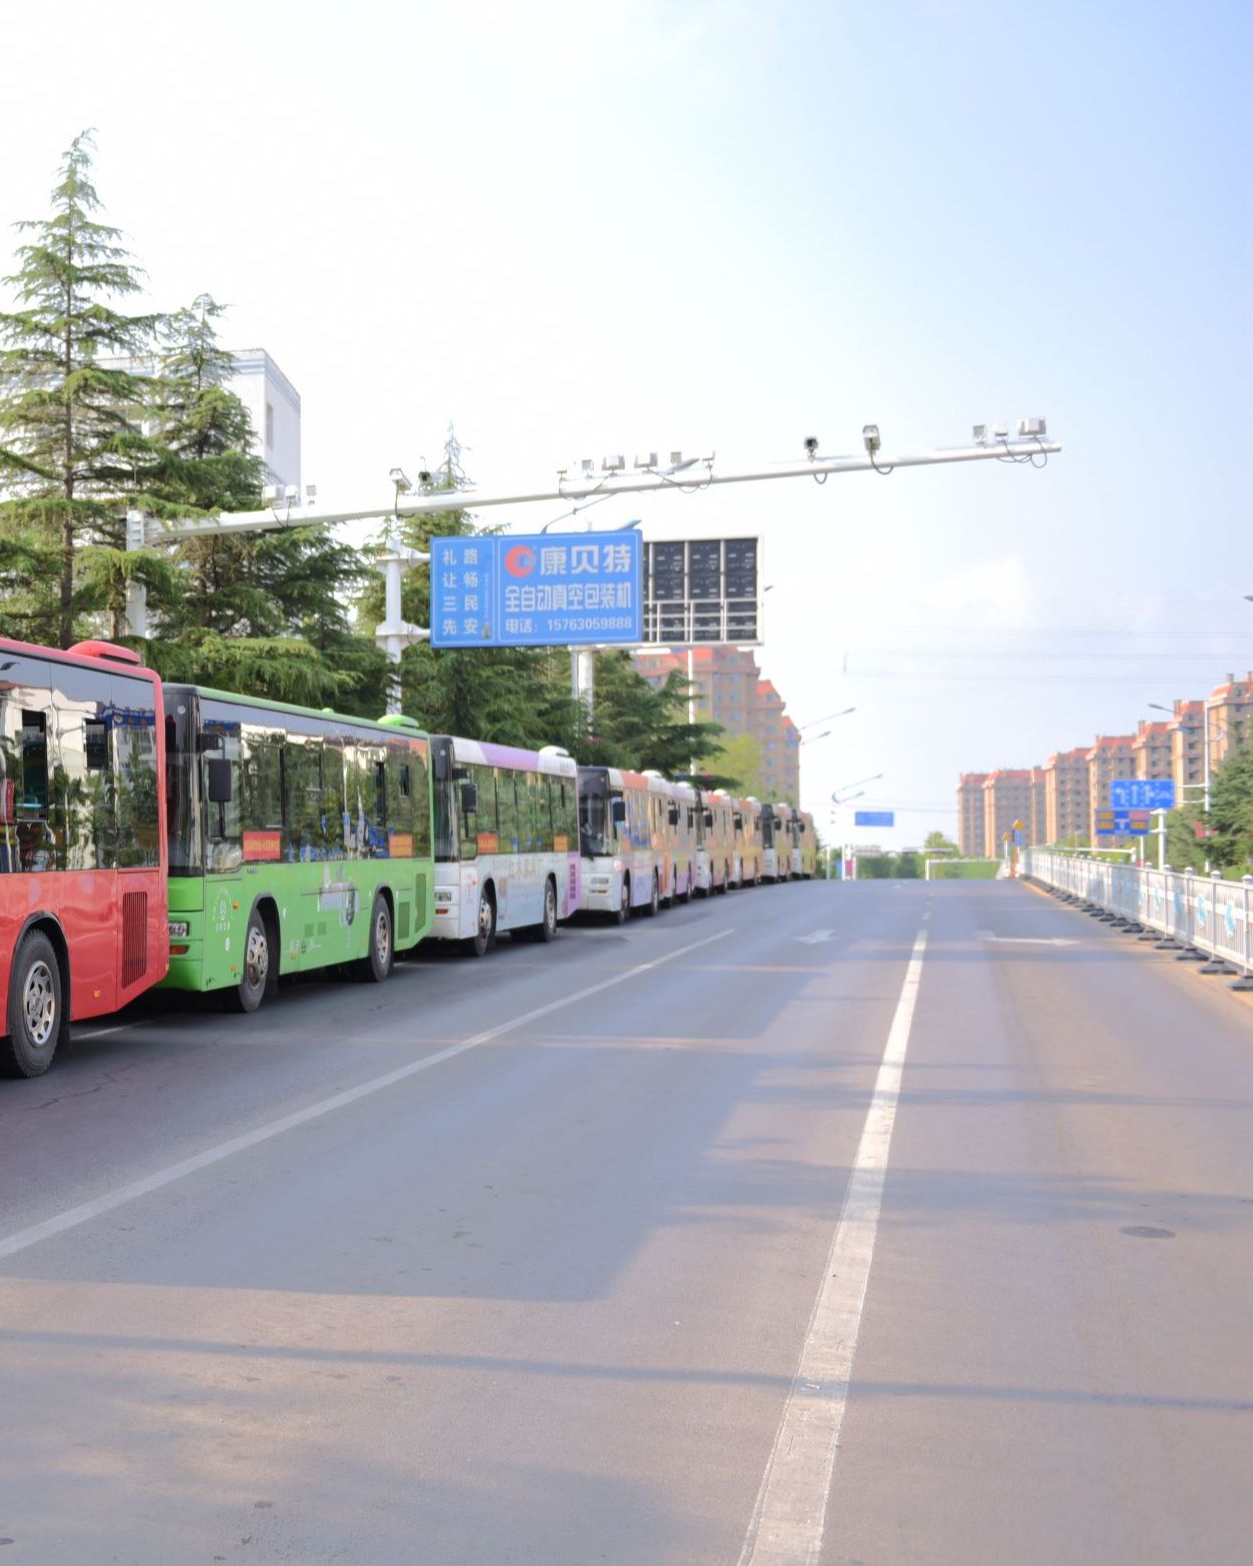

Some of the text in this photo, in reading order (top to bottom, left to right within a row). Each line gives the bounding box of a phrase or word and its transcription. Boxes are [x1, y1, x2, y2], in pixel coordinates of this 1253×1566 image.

[540, 544, 632, 576] 康贝特
[442, 548, 457, 636] 礼让三先
[505, 582, 632, 613] 全自动真空包装机
